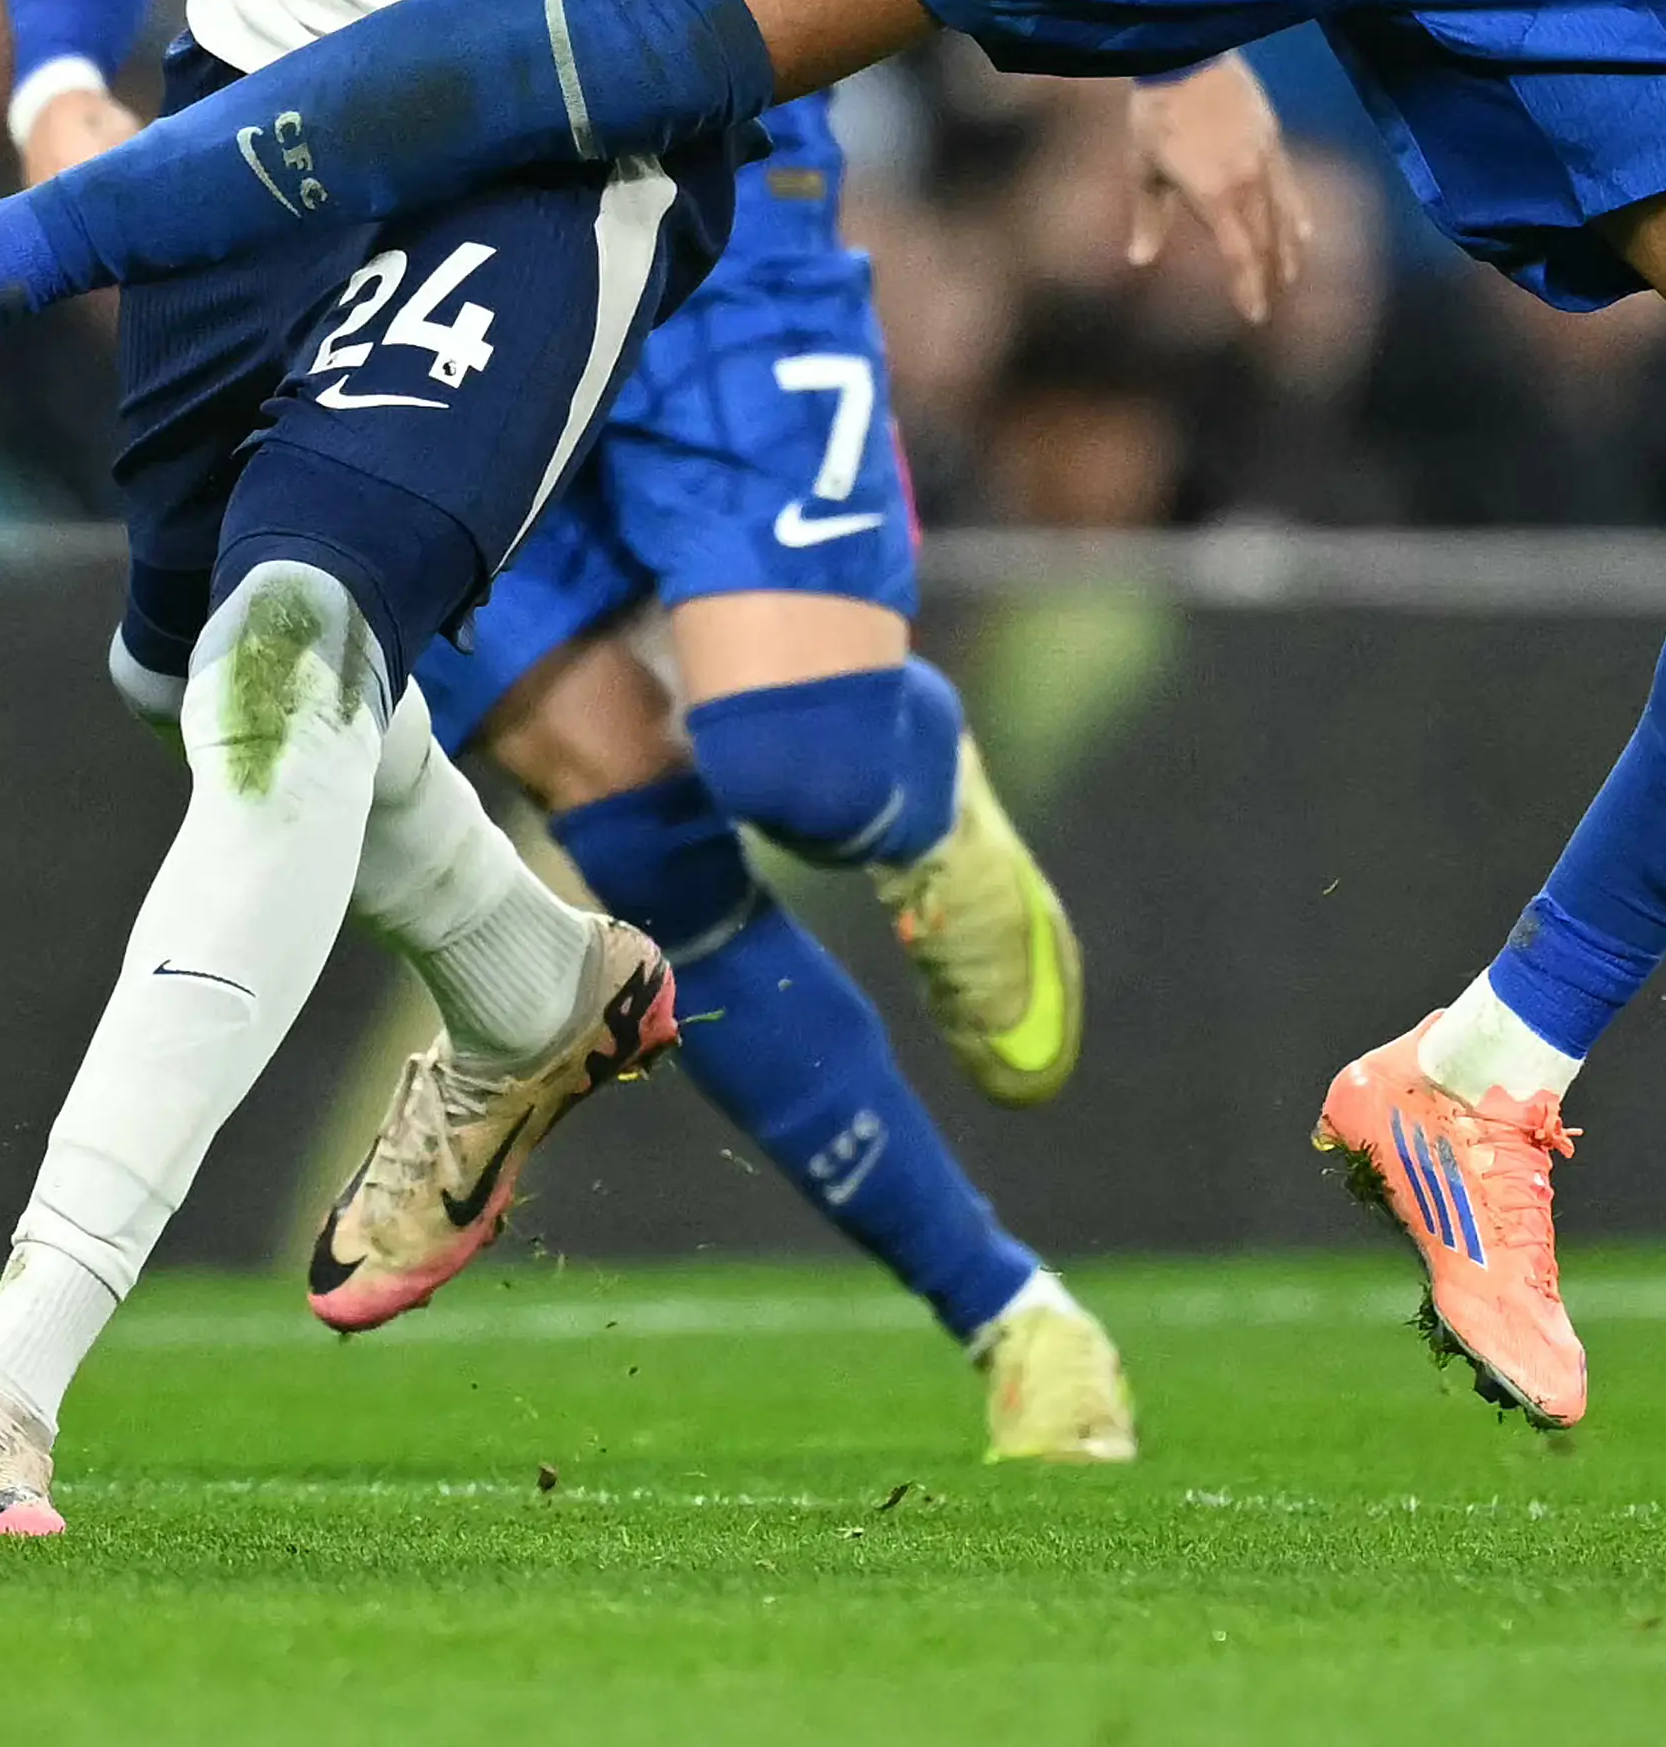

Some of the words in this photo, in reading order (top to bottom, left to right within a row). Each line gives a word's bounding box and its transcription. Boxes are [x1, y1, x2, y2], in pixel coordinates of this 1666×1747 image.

[274, 111, 329, 210] CFC
[307, 242, 497, 389] 24
[772, 353, 874, 501] 7
